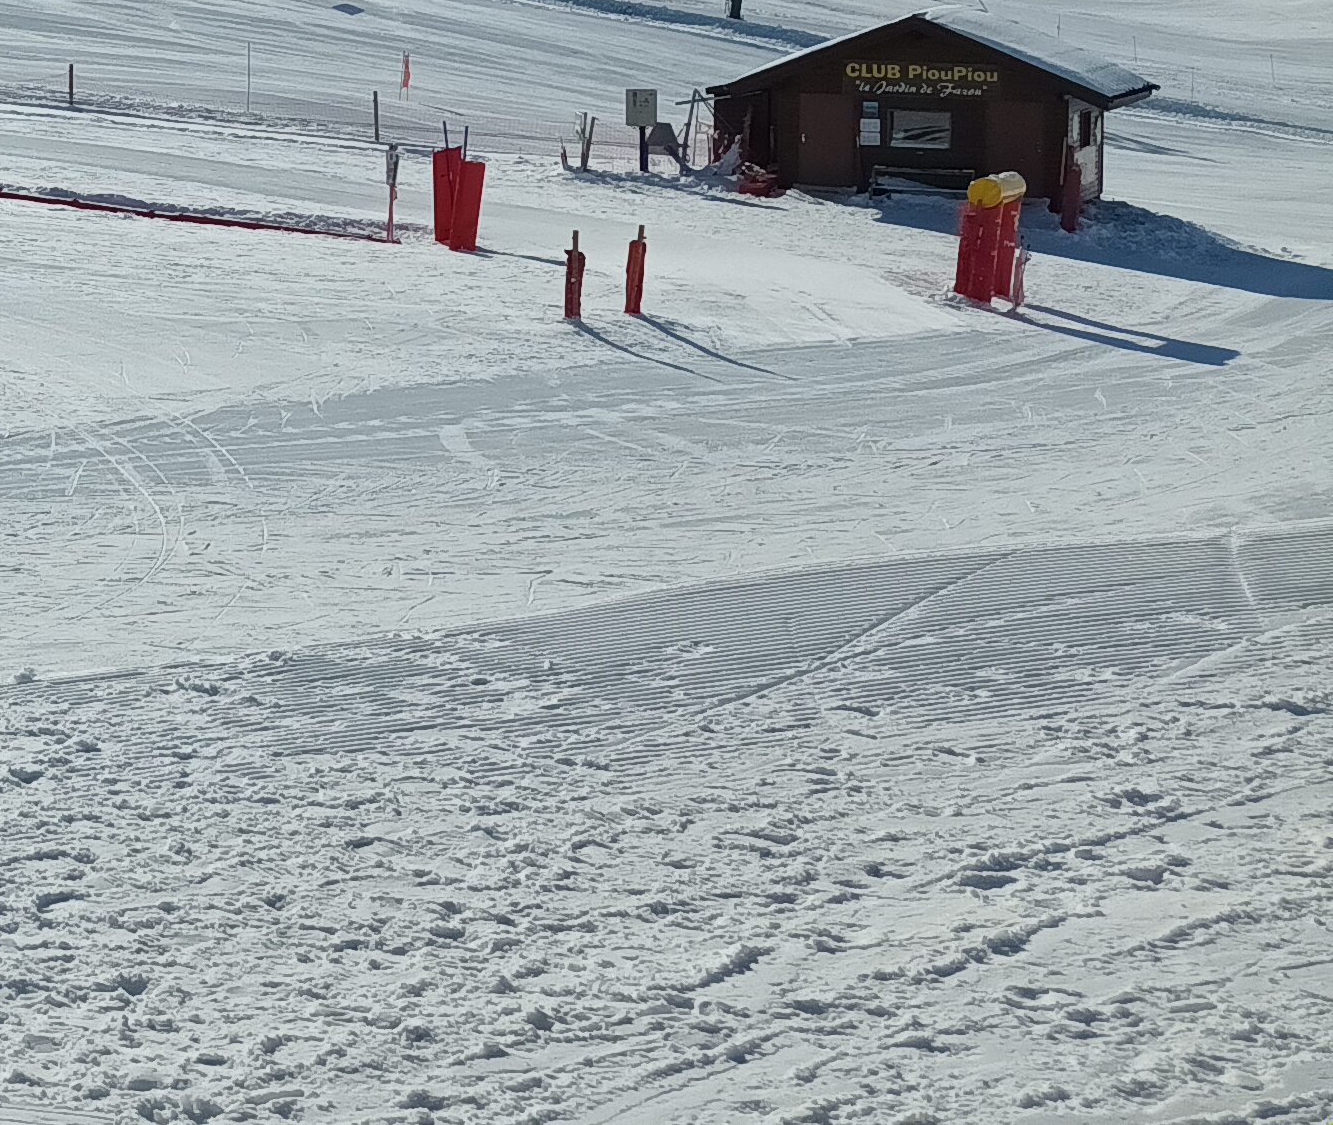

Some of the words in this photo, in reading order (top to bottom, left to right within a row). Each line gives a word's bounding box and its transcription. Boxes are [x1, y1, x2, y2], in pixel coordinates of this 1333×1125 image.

[845, 62, 901, 79] CLUB
[908, 65, 998, 82] PiouPiou
[873, 80, 916, 95] Jardin
[919, 83, 933, 94] de
